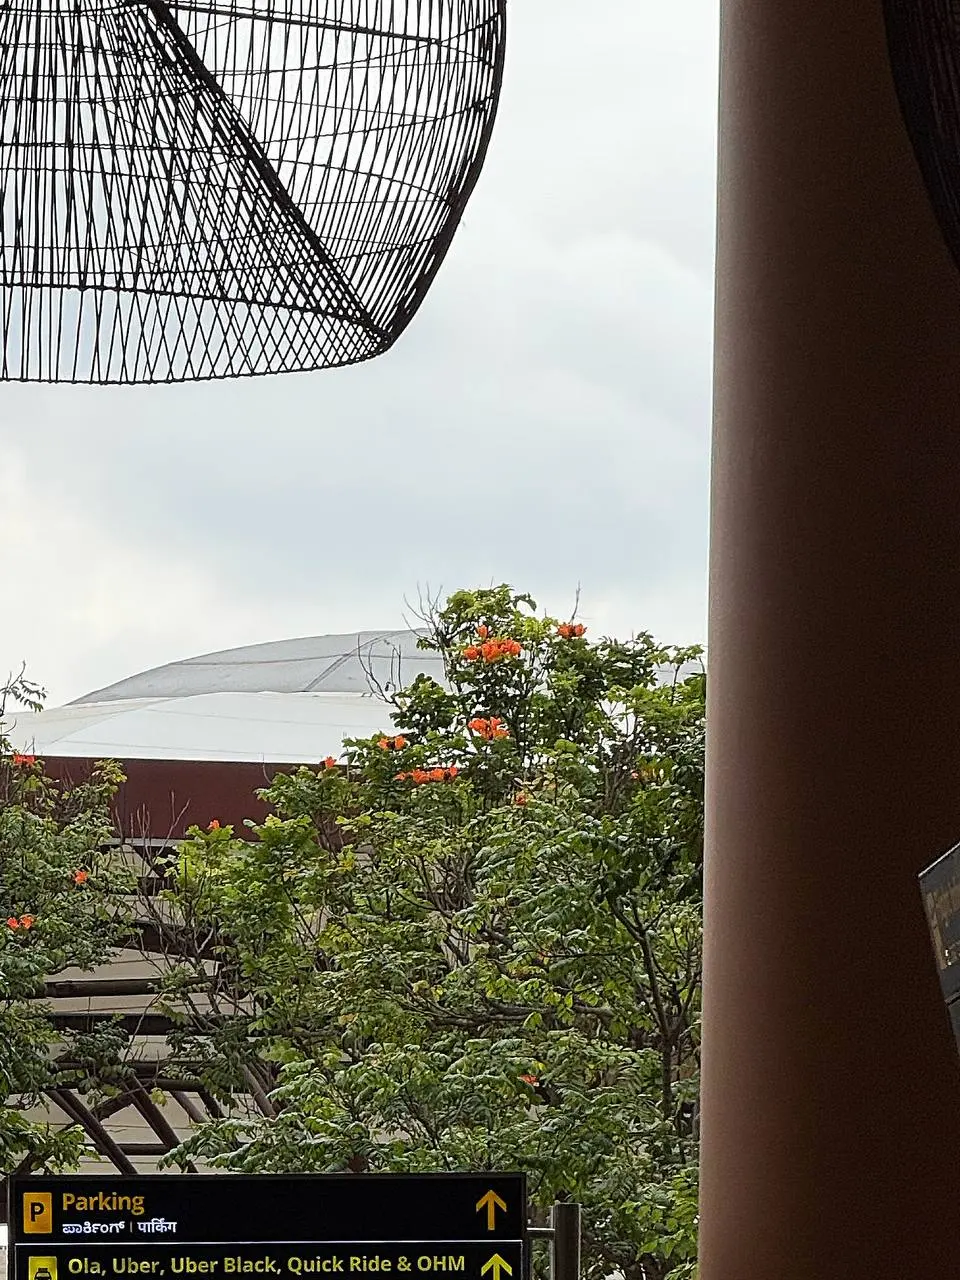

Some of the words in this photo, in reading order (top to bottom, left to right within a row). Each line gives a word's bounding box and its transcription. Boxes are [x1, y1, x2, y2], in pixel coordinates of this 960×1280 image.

[62, 1192, 145, 1215] Parking
[62, 1220, 125, 1234] ಪಾರ್ಕಿಂಗ್
[137, 1218, 177, 1233] पार्किंग
[68, 1257, 107, 1276] Ola,
[112, 1257, 165, 1276] Uber,
[171, 1257, 218, 1273] Uber
[224, 1256, 282, 1275] Black,
[287, 1256, 344, 1275] Quick
[349, 1255, 392, 1272] Ride
[397, 1256, 412, 1272] &
[417, 1255, 465, 1272] OHM
